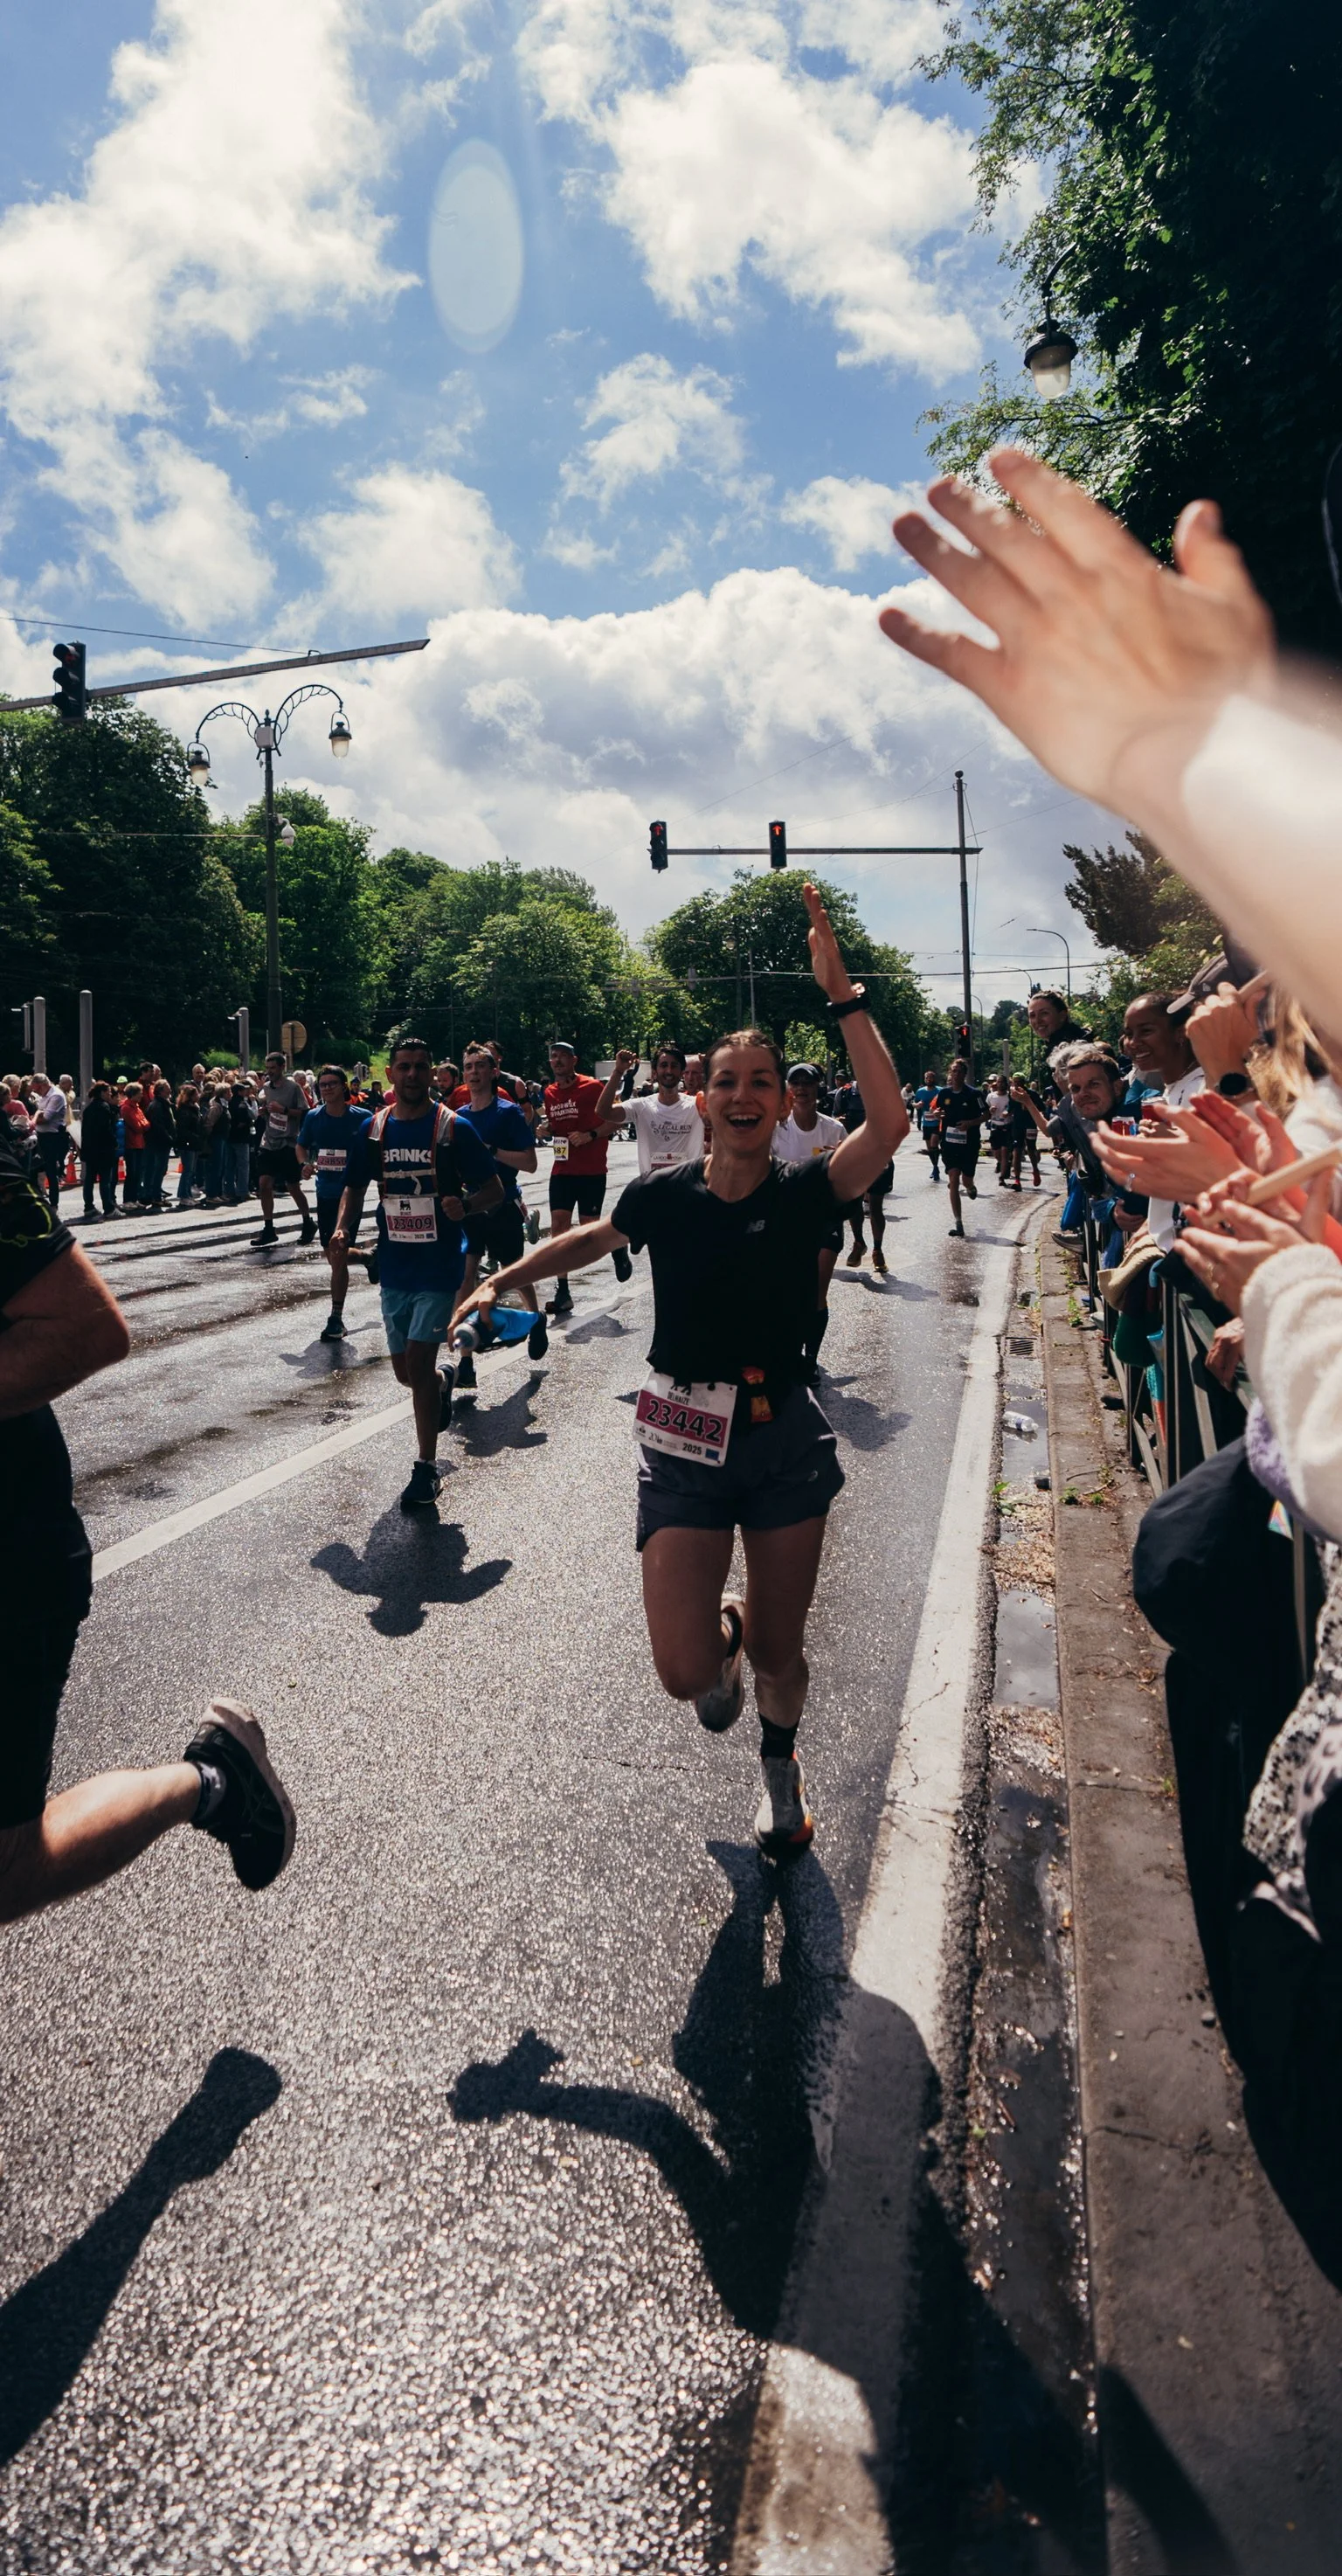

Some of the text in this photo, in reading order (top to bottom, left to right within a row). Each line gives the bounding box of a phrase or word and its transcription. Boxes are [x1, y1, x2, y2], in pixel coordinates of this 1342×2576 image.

[393, 1217, 432, 1229] 23409
[668, 1391, 690, 1406] DELHAIZE
[647, 1399, 723, 1443] 23442
[682, 1443, 702, 1455] 2025
